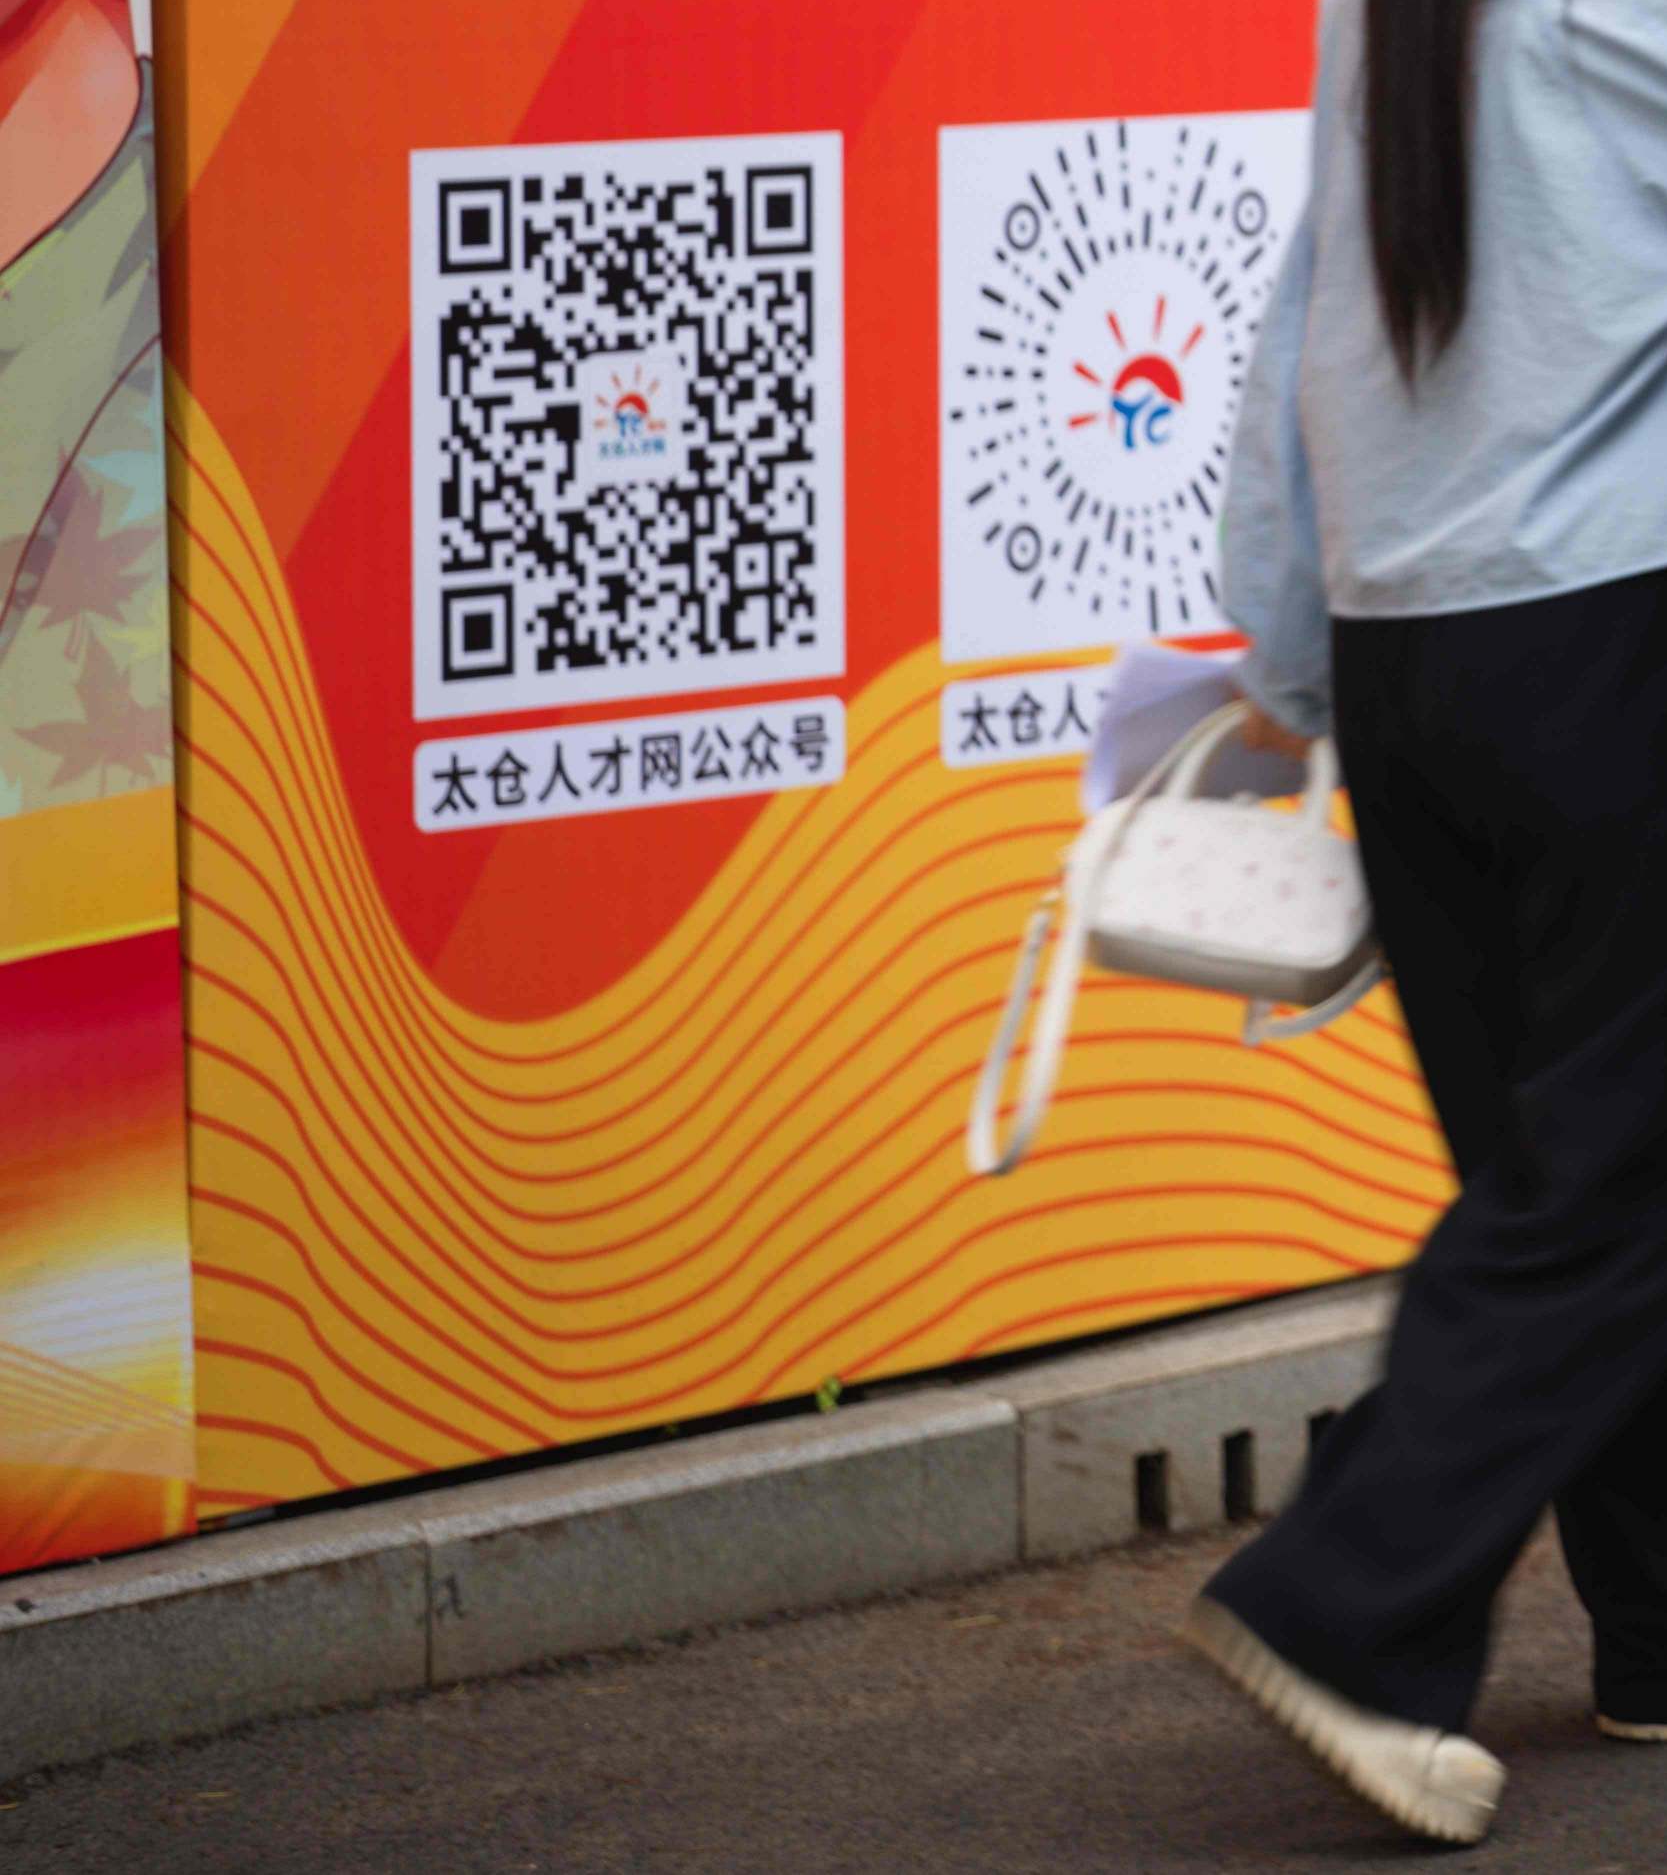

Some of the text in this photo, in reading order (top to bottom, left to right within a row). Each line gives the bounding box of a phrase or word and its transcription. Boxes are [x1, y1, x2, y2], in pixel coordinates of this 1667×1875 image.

[430, 709, 831, 815] 太仓人才网公众号
[957, 681, 1110, 755] 太仓人
